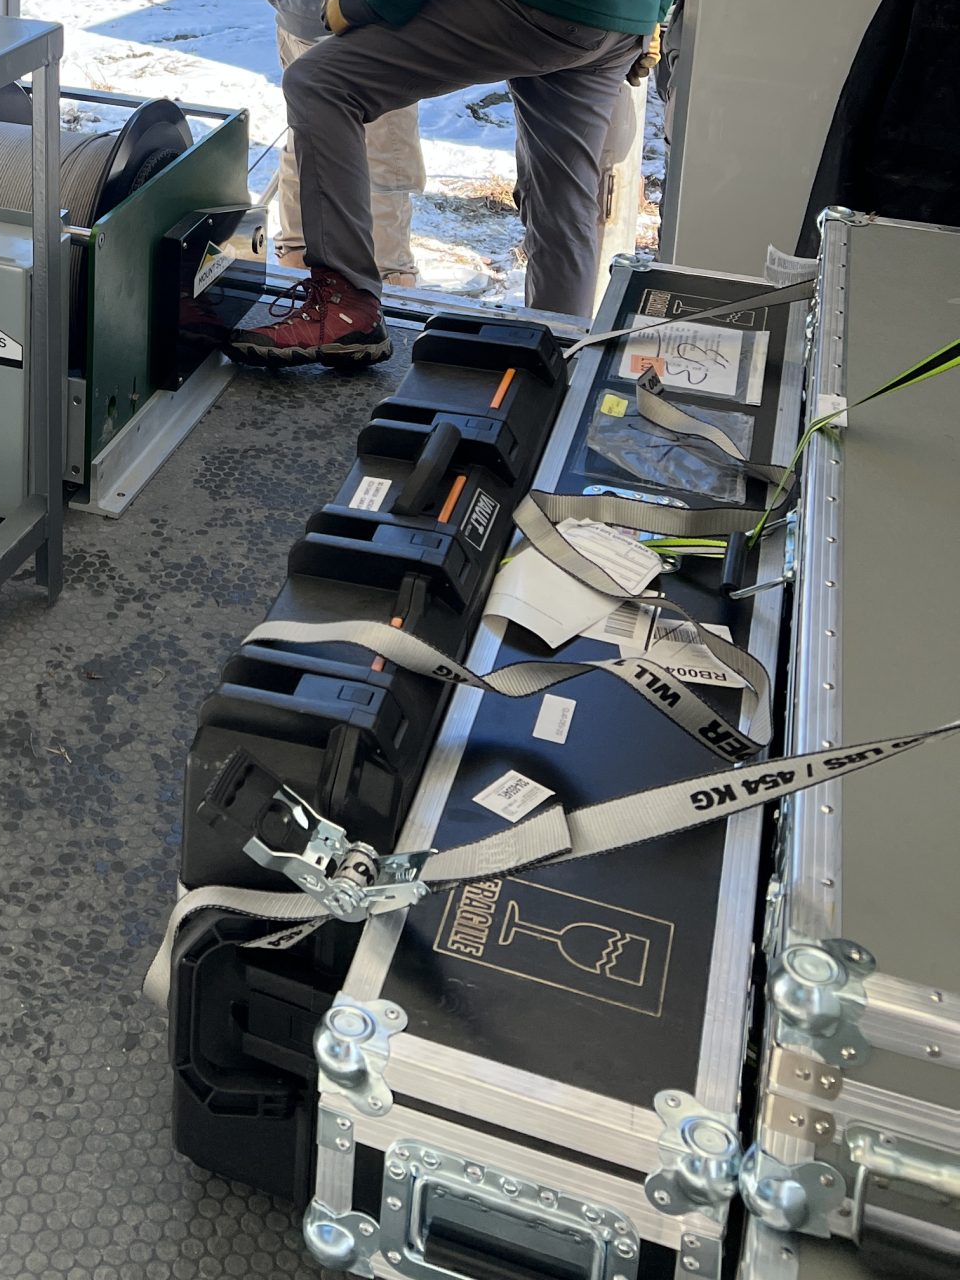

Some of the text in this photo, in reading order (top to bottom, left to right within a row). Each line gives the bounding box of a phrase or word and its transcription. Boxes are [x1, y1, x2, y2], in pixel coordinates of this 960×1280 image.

[471, 492, 495, 535] VAULT
[634, 664, 682, 708] WLL
[690, 784, 738, 811] KG
[741, 770, 796, 796] 454
